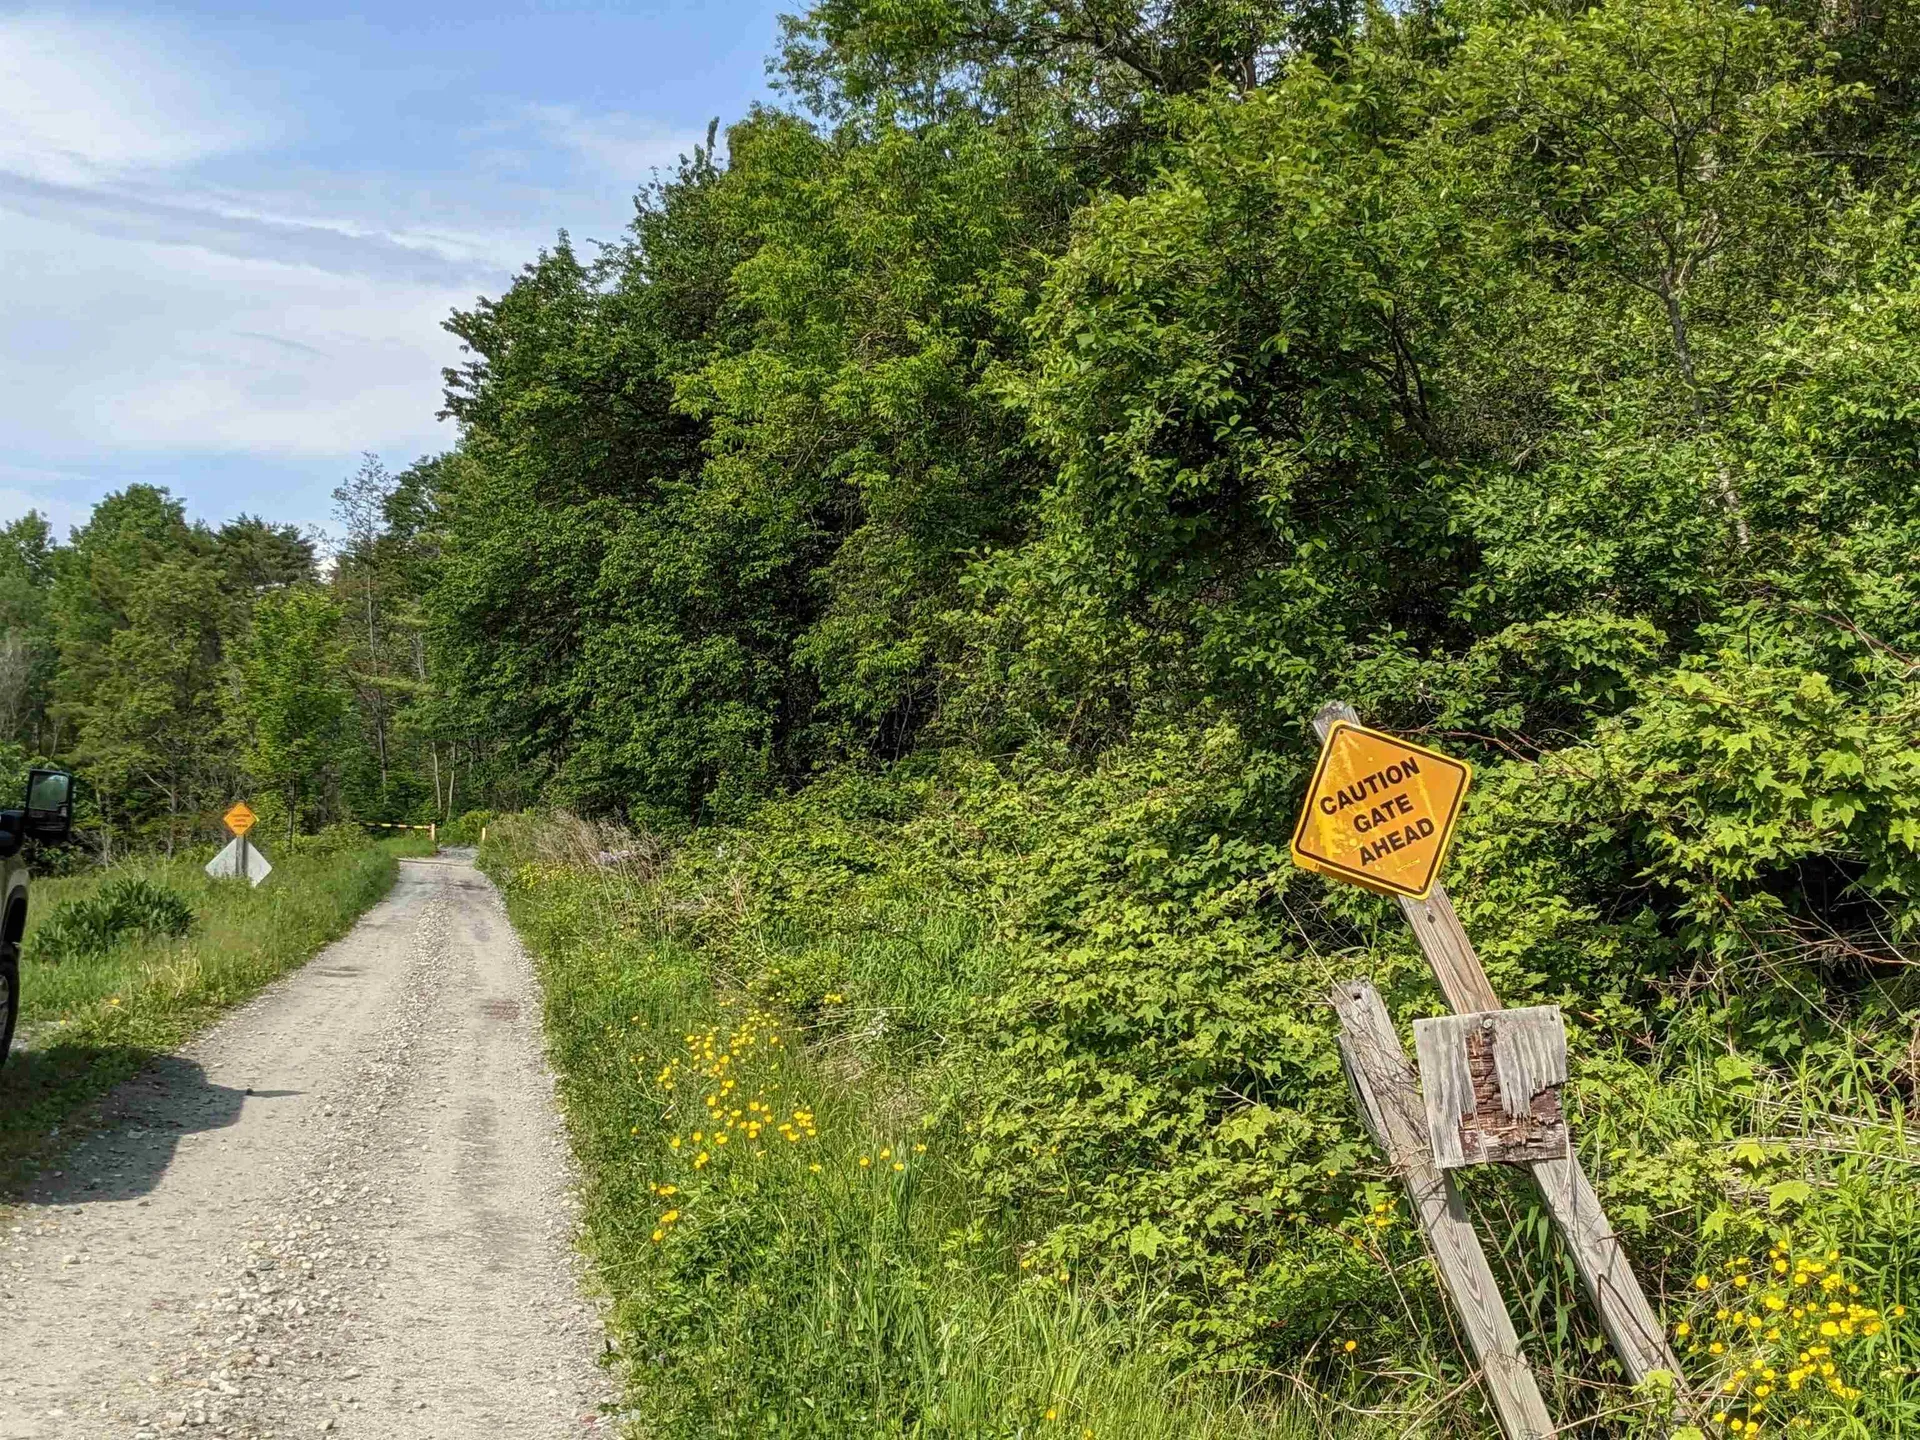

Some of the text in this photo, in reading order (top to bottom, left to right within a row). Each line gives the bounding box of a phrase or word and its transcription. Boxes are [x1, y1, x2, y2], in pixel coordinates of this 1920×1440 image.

[1320, 757, 1420, 815] CAUTION
[1353, 793, 1414, 833] GATE
[1359, 817, 1435, 866] AHEAD
